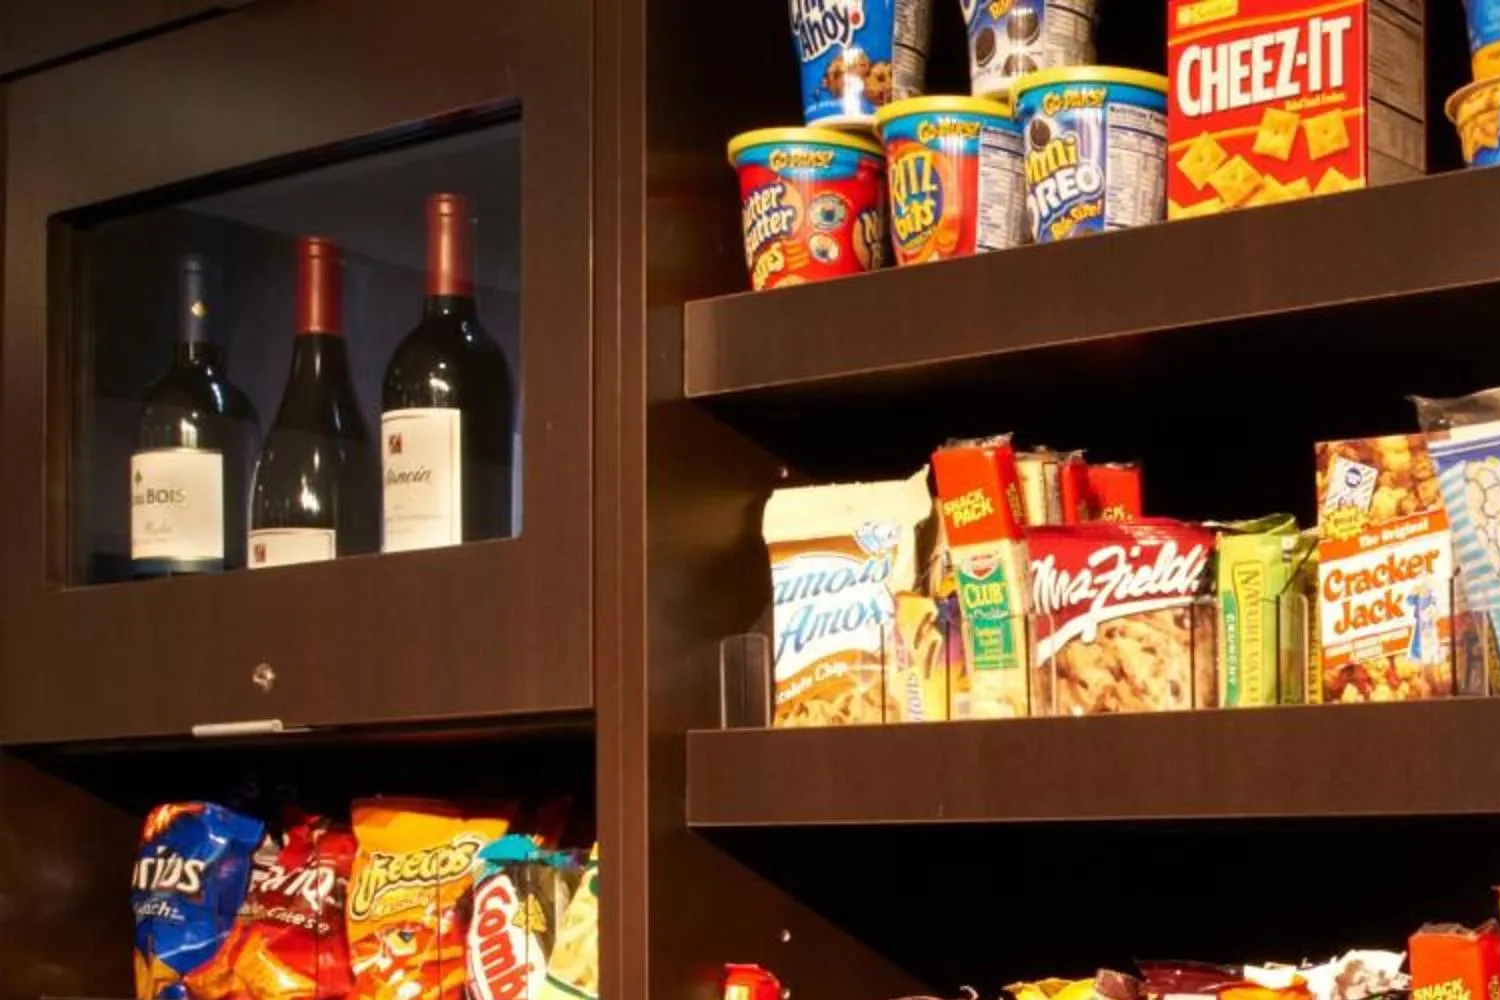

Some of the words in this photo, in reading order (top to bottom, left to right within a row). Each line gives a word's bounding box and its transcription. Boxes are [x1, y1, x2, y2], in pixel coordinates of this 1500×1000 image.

[1177, 17, 1351, 117] CHEEZ-IT
[146, 487, 187, 505] BOIS
[952, 497, 994, 528] PACK
[1323, 548, 1441, 603] Cracker
[775, 597, 885, 664] Amos
[1333, 586, 1405, 636] Jack
